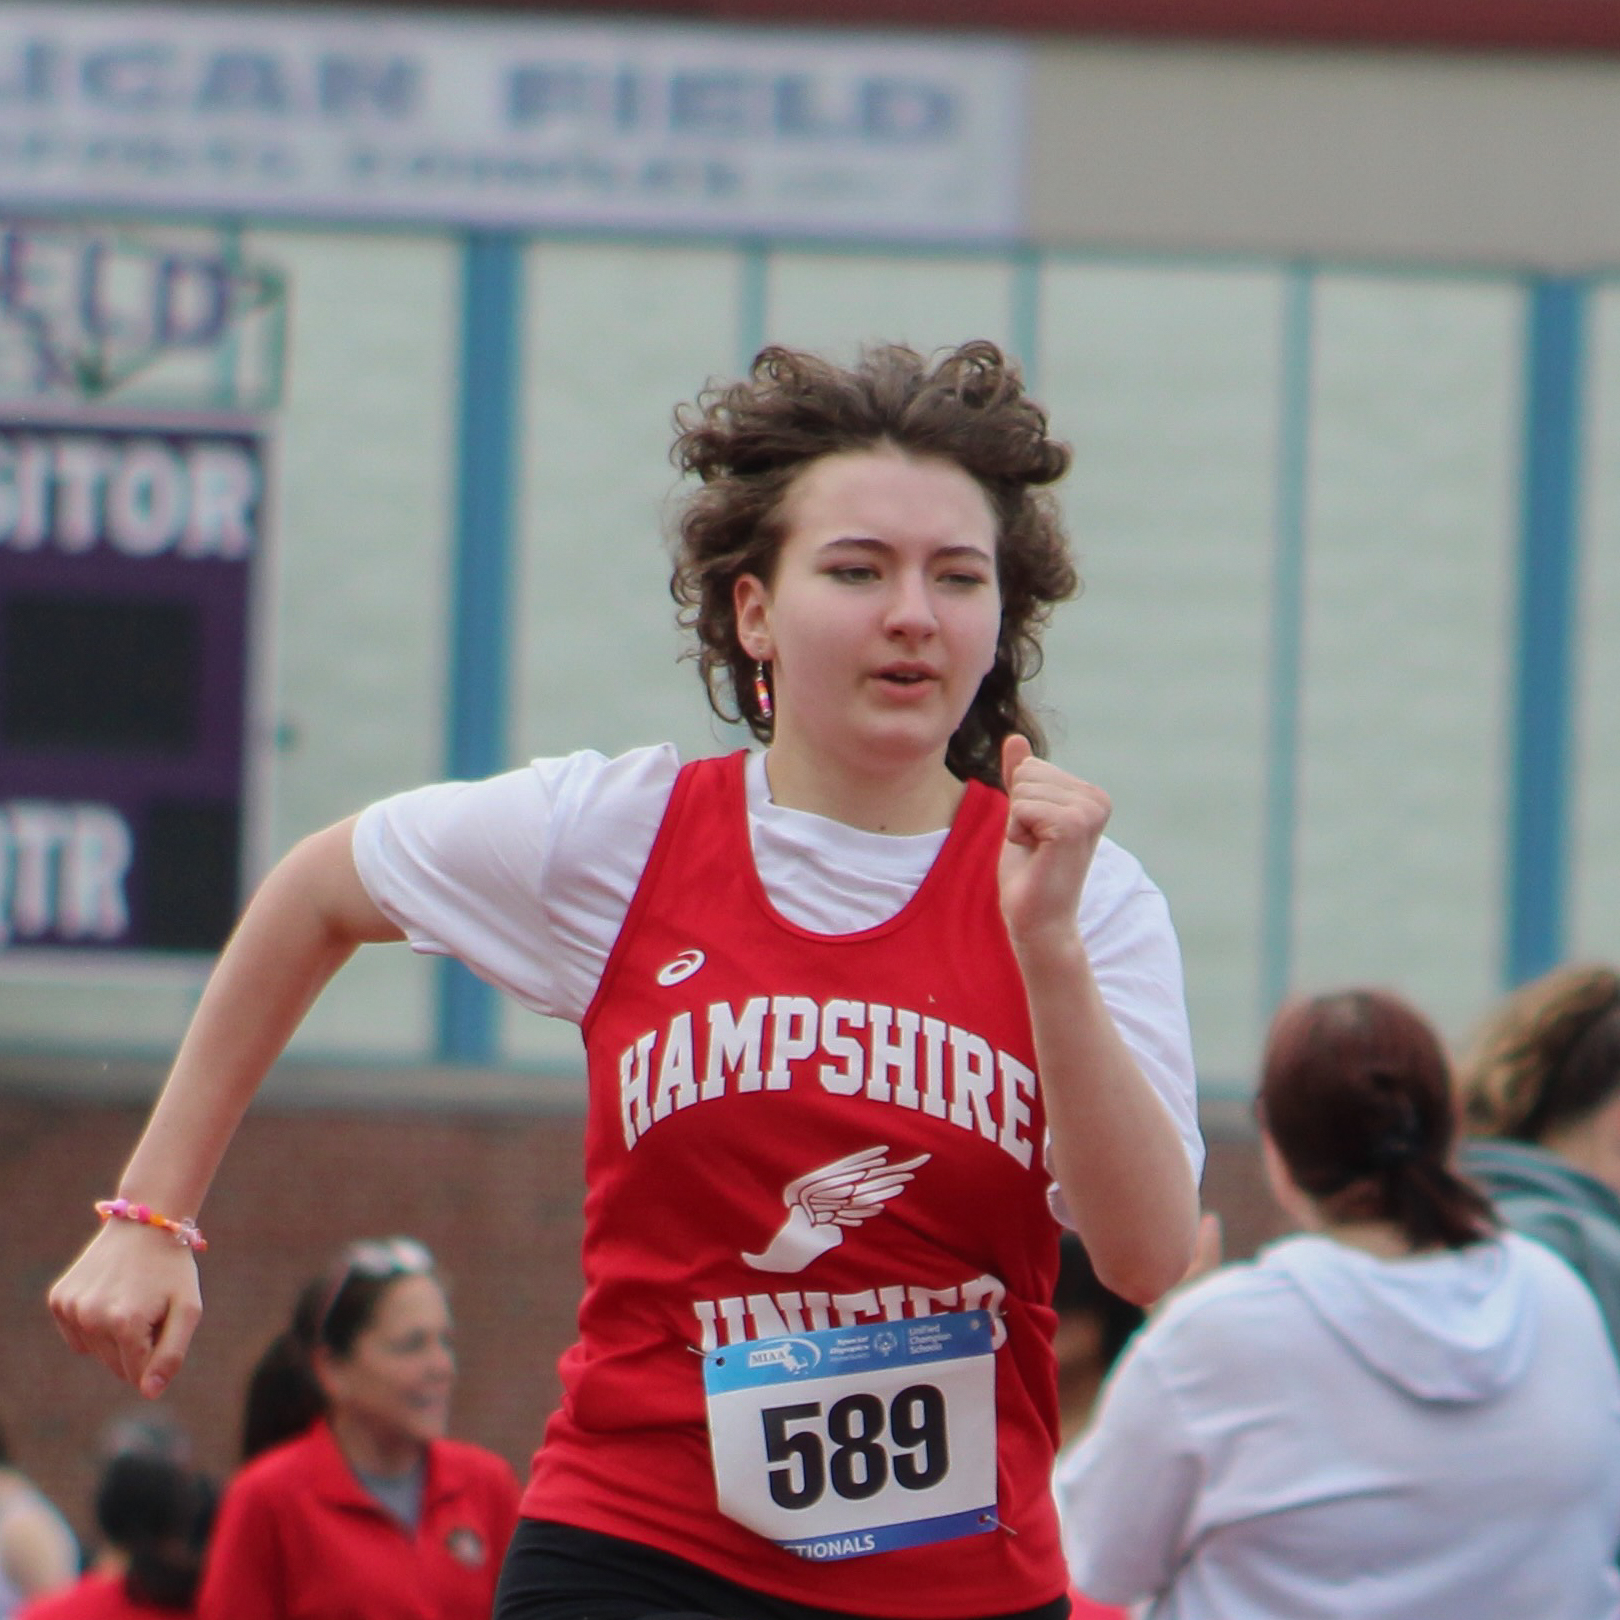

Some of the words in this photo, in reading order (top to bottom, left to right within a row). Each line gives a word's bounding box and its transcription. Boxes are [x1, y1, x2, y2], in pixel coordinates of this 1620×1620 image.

[507, 60, 957, 145] FIELD
[617, 996, 1036, 1170] HAMPSHIRE
[760, 1384, 951, 1510] 589
